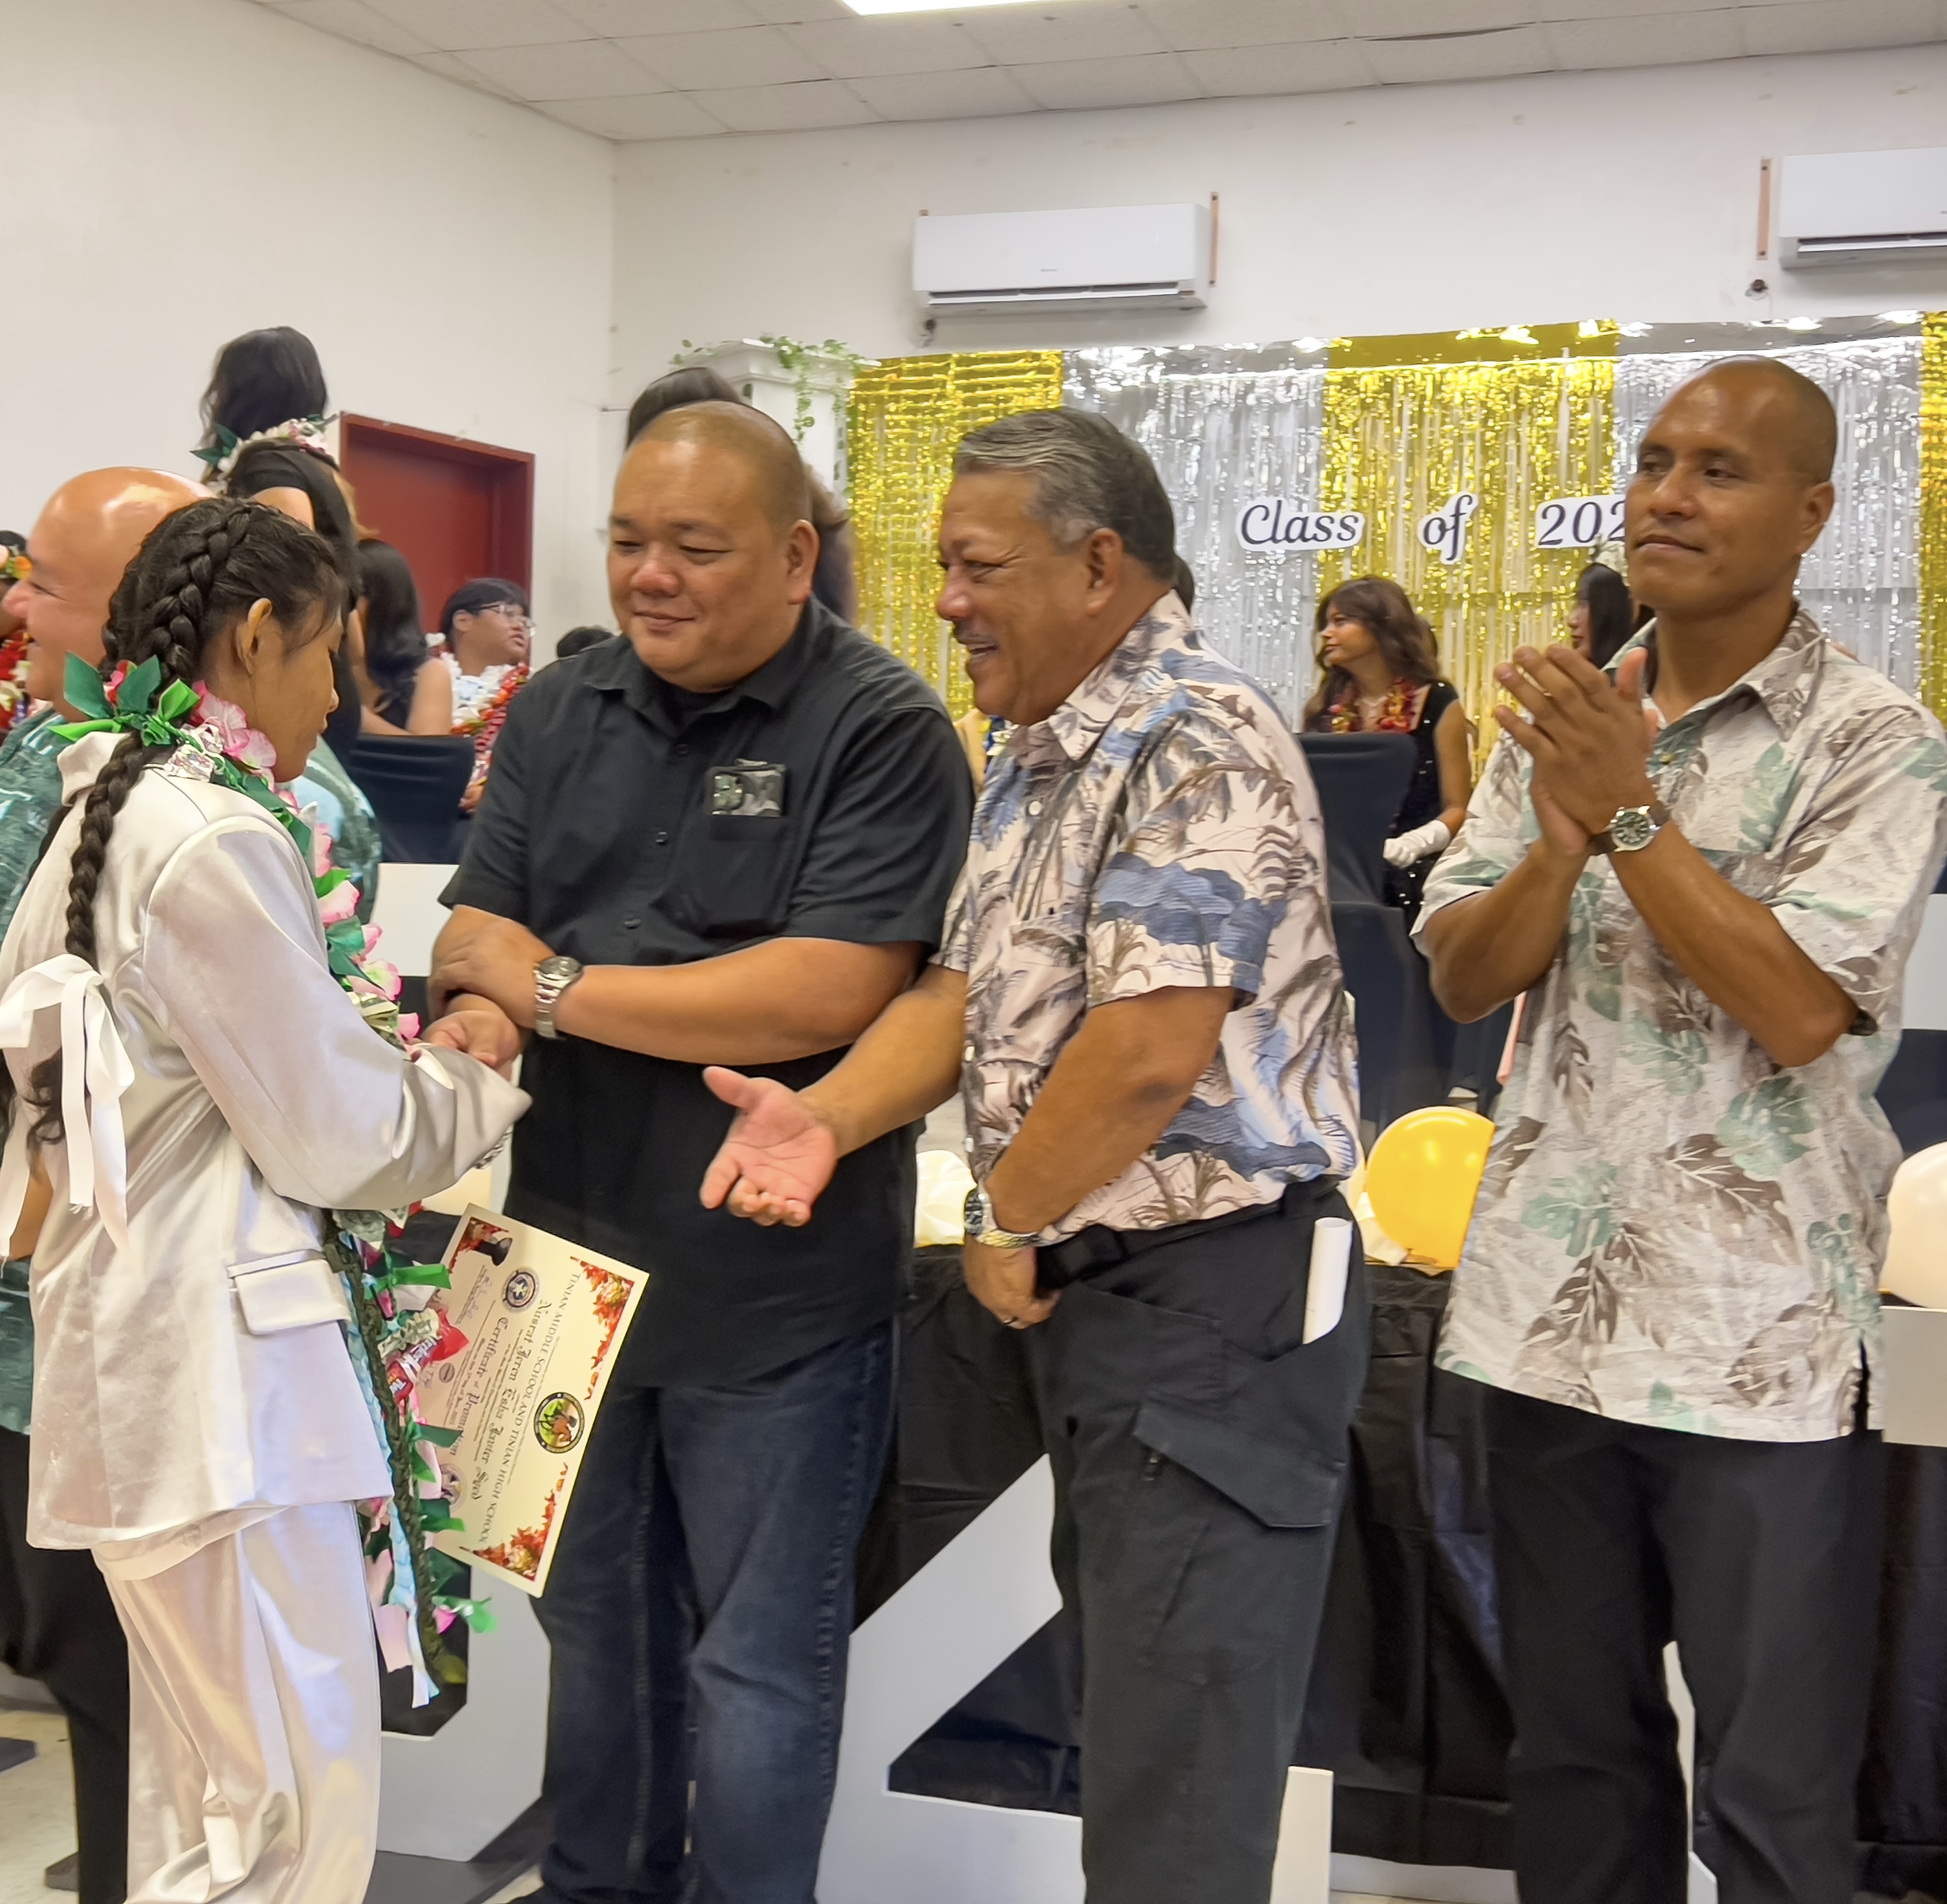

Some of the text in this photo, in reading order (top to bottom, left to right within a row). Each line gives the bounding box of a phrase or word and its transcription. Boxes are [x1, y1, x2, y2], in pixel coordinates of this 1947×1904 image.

[1240, 499, 1359, 545] Class
[1422, 494, 1473, 561] of
[477, 1317, 508, 1377] Certificate
[479, 1274, 580, 1542] TINIAN MIDDLE SCHOOL AND TINIAN HIGH SCHOOL
